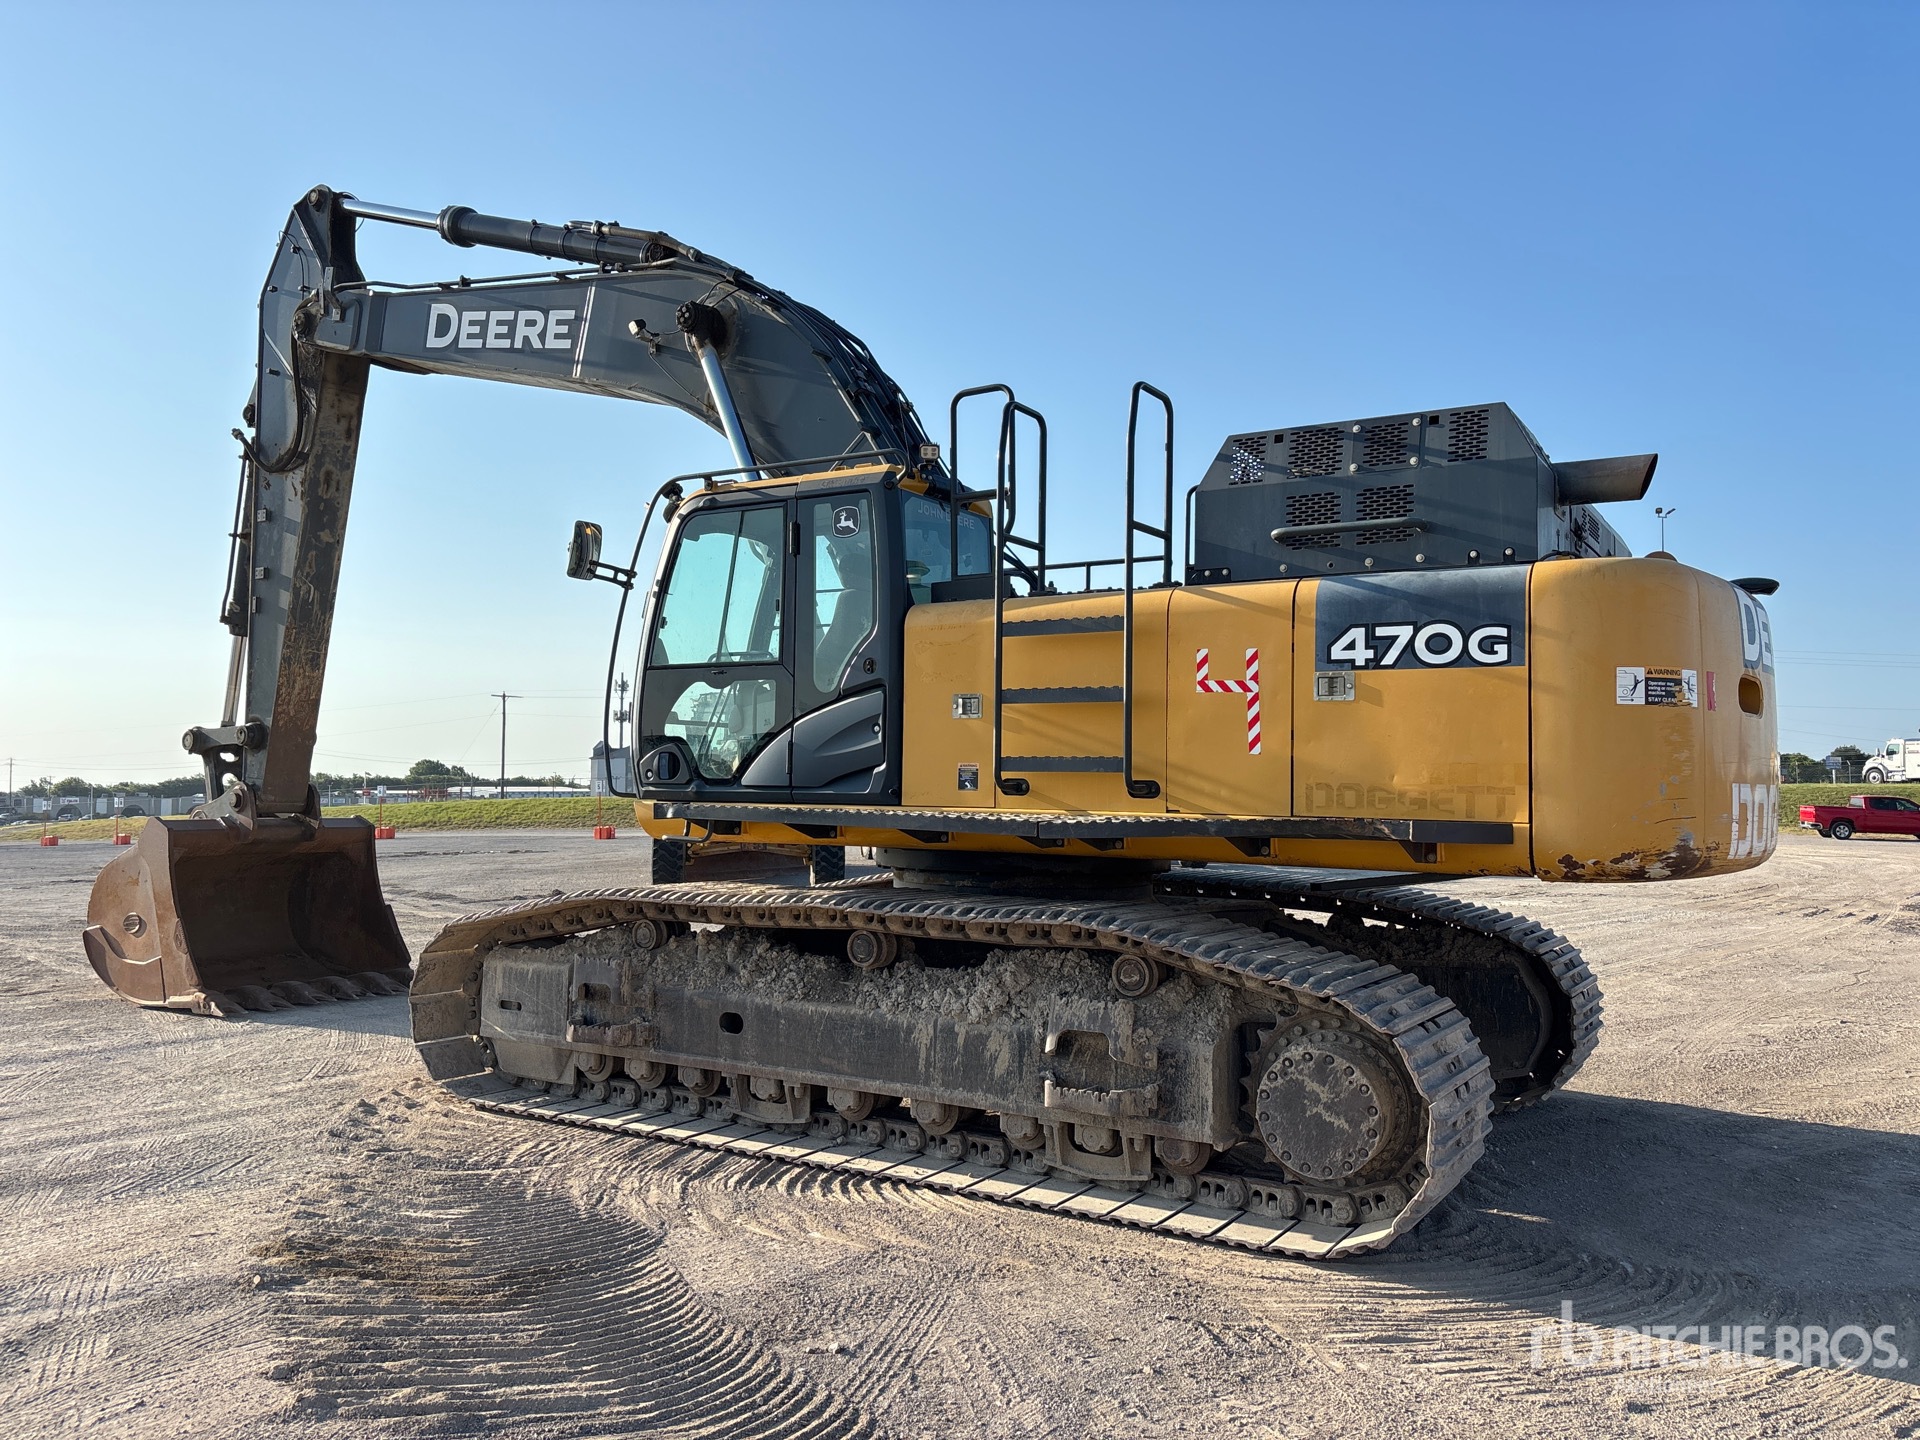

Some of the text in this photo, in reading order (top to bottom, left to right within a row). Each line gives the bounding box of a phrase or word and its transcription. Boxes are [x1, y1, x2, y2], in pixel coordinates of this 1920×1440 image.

[426, 303, 576, 349] DEERE
[918, 502, 975, 530] JOHN DERE
[1329, 621, 1509, 668] 470G
[1653, 668, 1681, 676] WARNING
[1196, 648, 1261, 755] 4
[1305, 782, 1516, 819] DOGGETT
